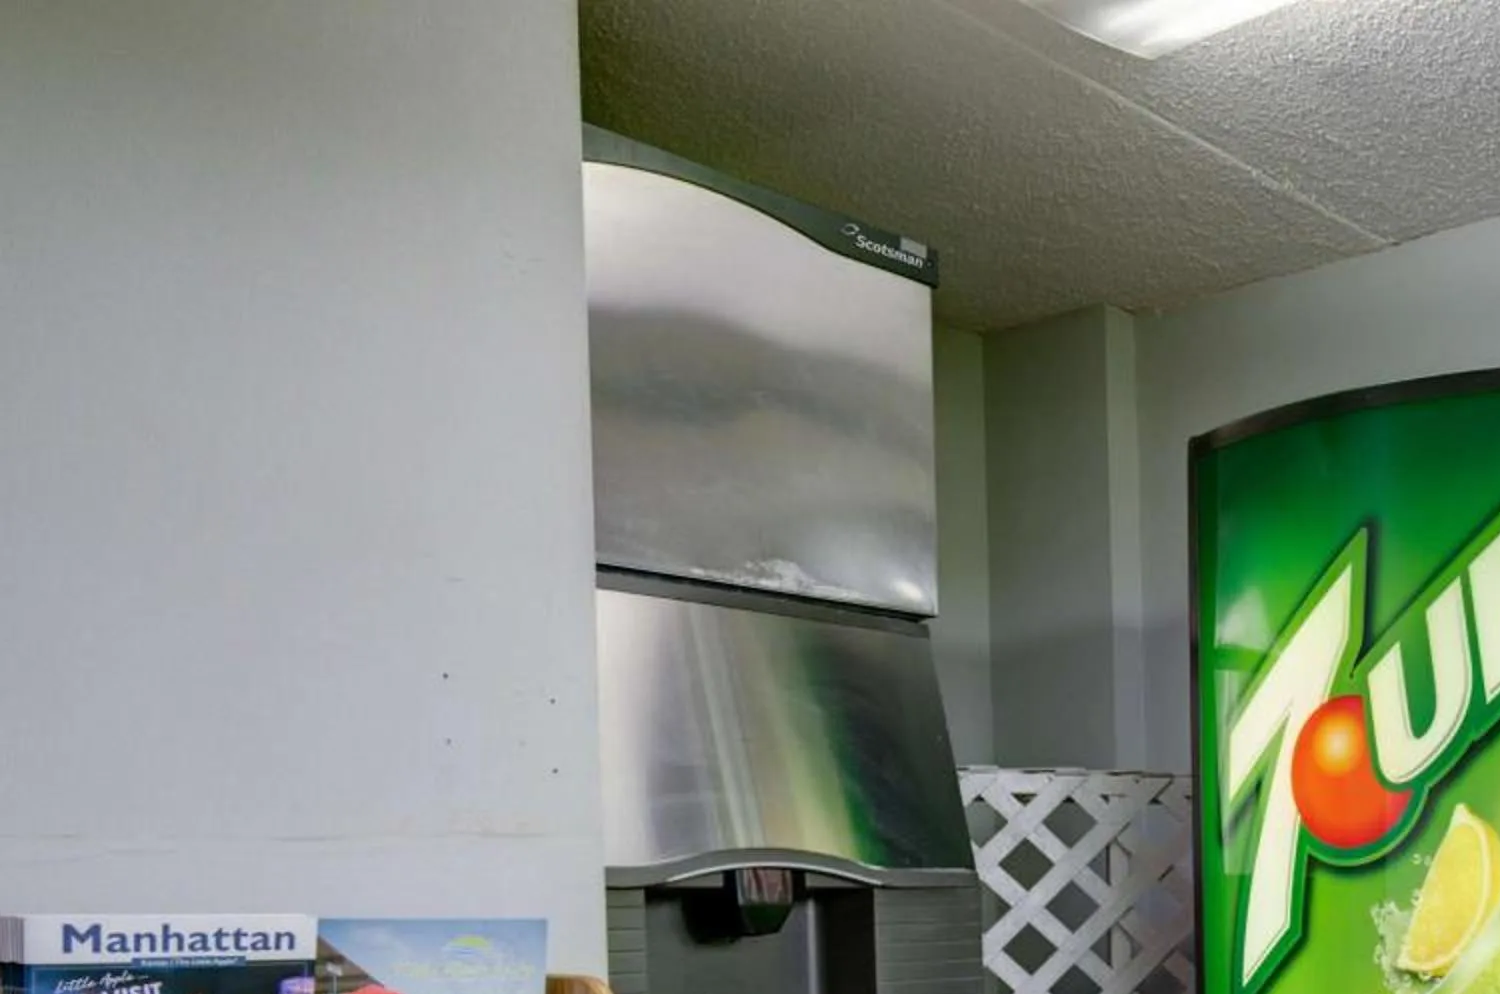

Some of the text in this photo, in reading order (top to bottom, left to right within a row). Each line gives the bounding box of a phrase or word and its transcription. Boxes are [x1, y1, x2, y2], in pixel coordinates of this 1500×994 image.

[854, 234, 924, 269] Scotsman
[61, 922, 296, 955] Manhattan
[55, 970, 132, 994] Little Apple
